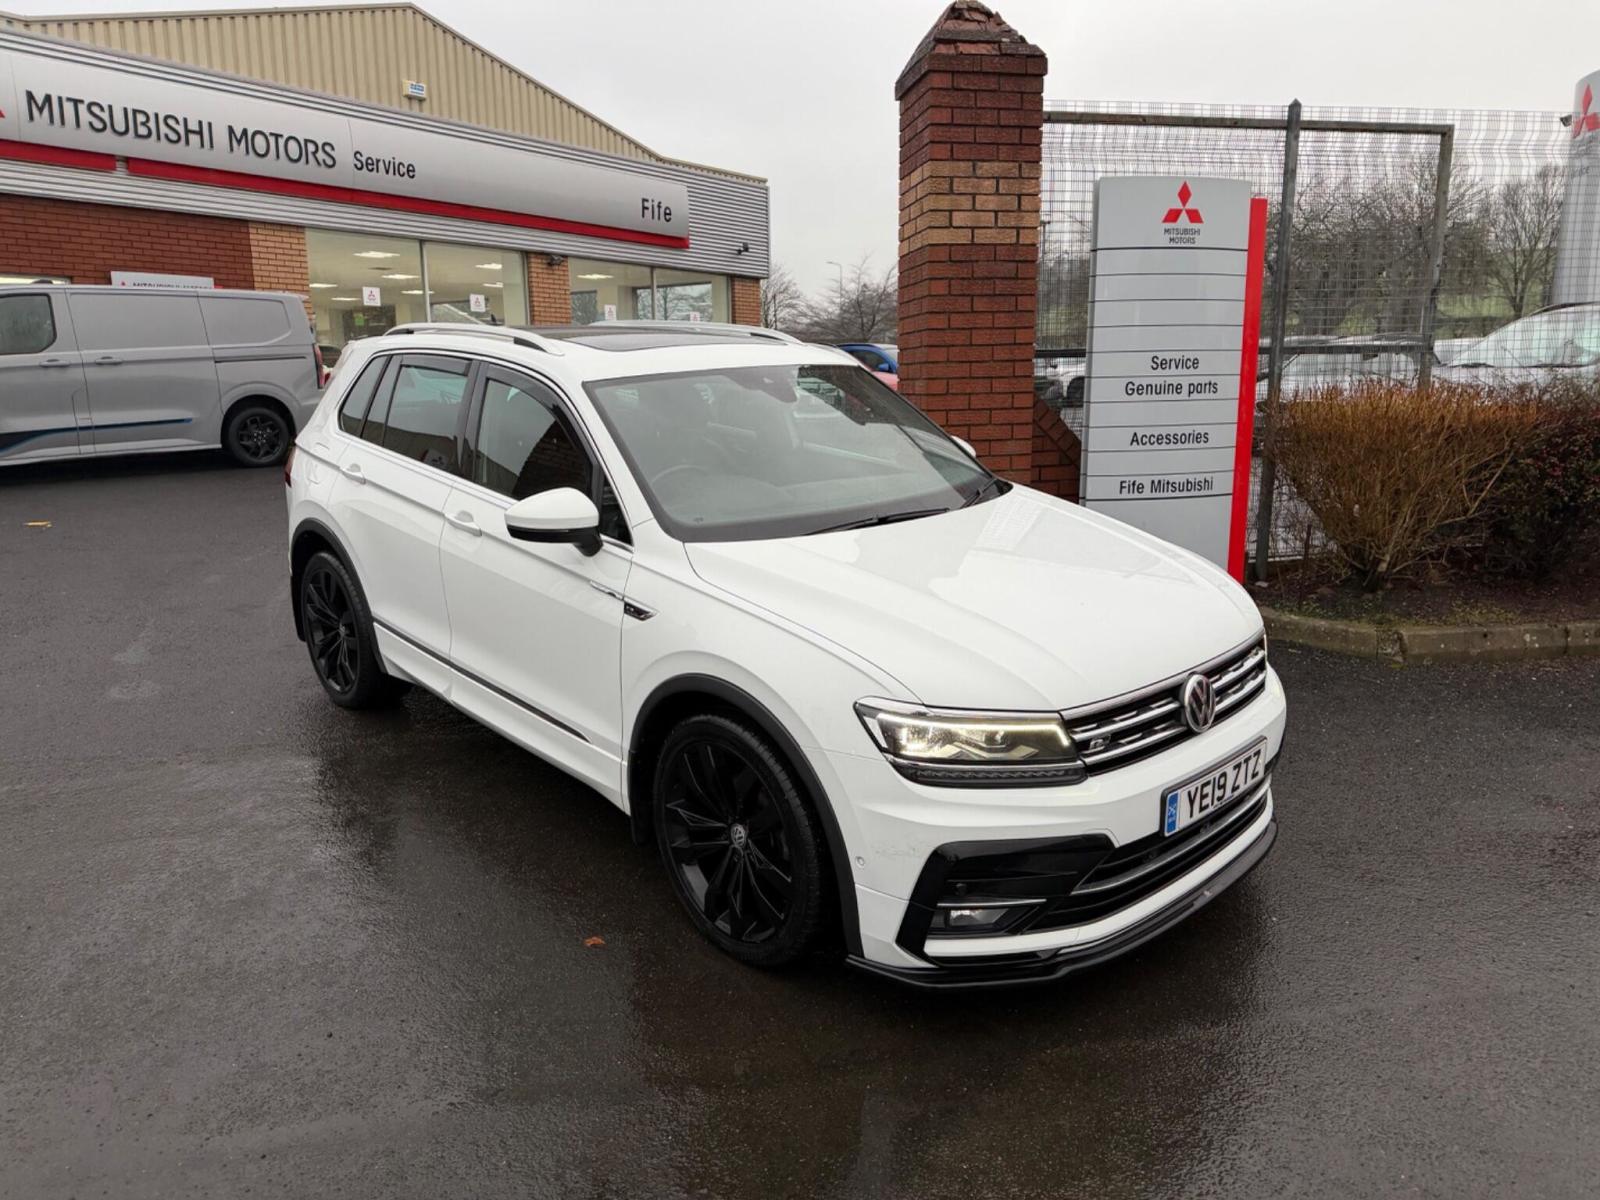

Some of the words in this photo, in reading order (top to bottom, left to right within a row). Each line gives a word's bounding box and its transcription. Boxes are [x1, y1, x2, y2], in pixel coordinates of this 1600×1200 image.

[25, 89, 215, 150] MITSUBISHI
[227, 124, 338, 169] MOTORS
[353, 150, 417, 179] Service
[641, 198, 673, 223] Fife
[1164, 228, 1201, 236] MITSUBISHI
[1169, 237, 1196, 245] MOTORS
[1151, 355, 1200, 371] Service
[1125, 380, 1183, 396] Genuine
[1188, 380, 1219, 397] parts
[1130, 430, 1210, 446] Accessories
[1119, 480, 1145, 495] Fife
[1150, 477, 1214, 494] Mitsubishi
[1187, 771, 1228, 819] YE19
[1230, 749, 1262, 794] ZTZ
